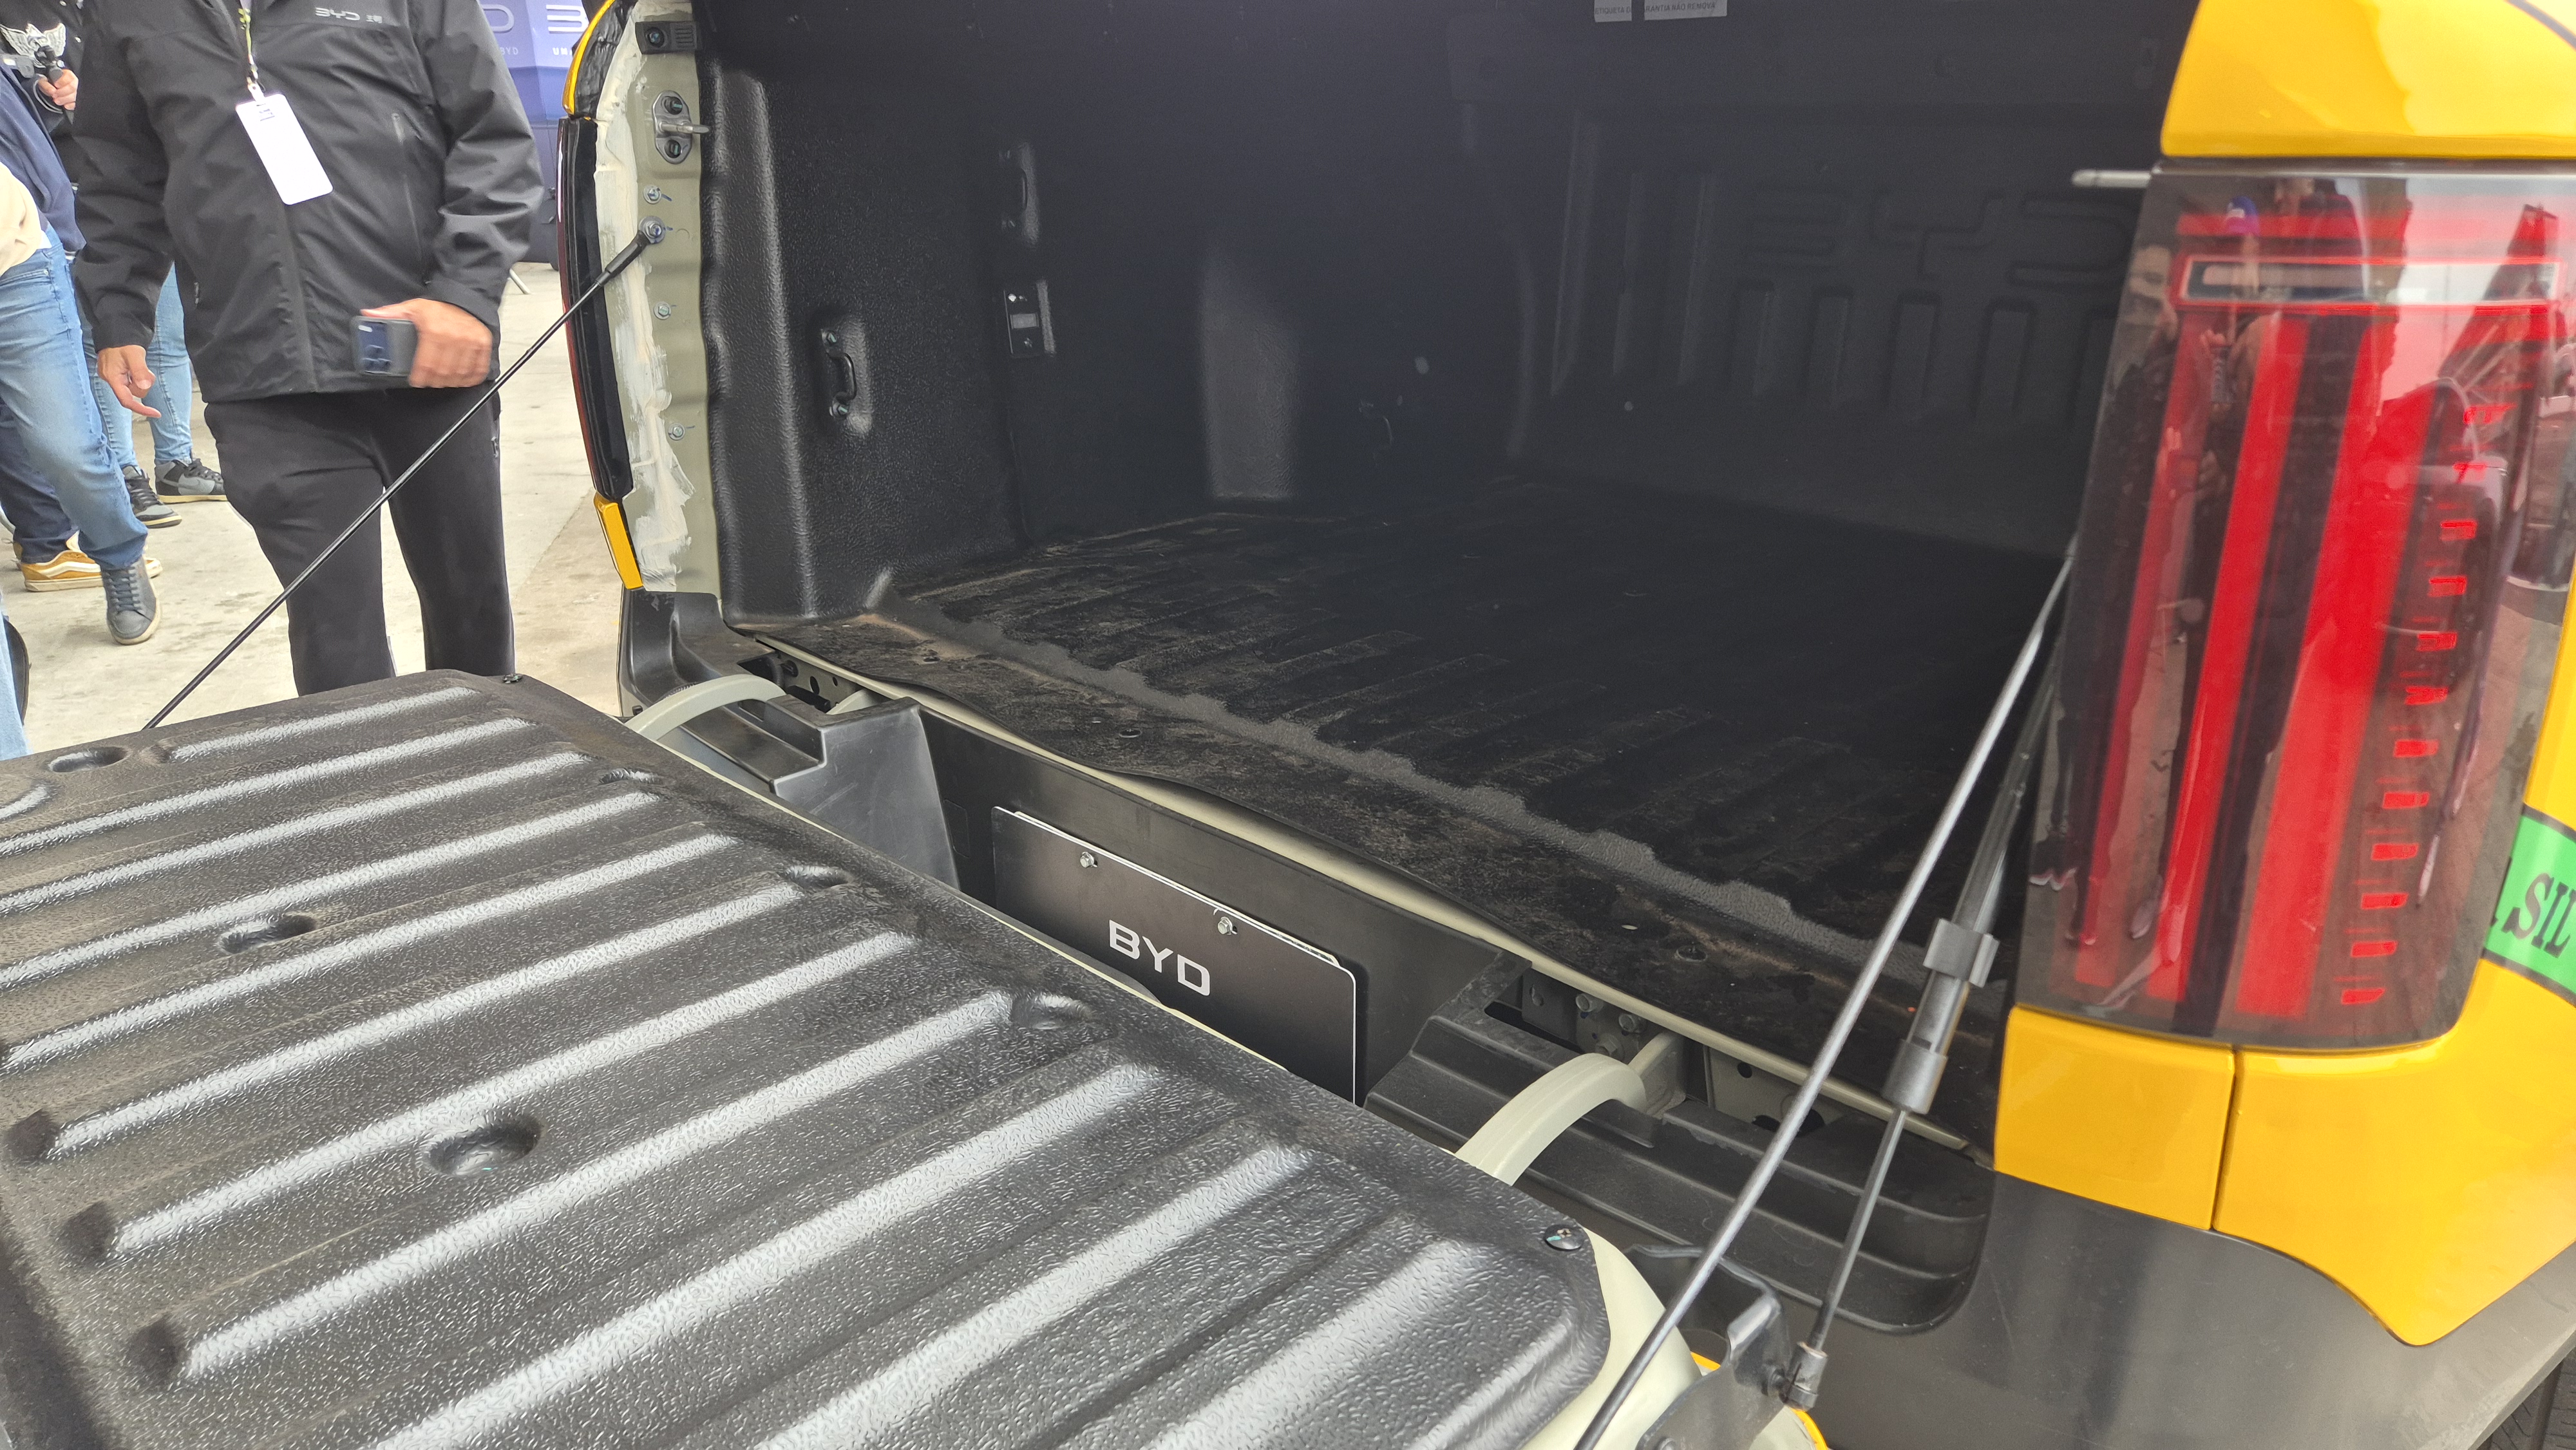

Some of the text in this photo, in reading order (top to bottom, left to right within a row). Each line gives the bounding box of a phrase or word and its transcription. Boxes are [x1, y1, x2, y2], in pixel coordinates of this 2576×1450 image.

[315, 7, 361, 21] BYD
[2491, 863, 2576, 959] SIL
[1108, 919, 1211, 996] BYD
